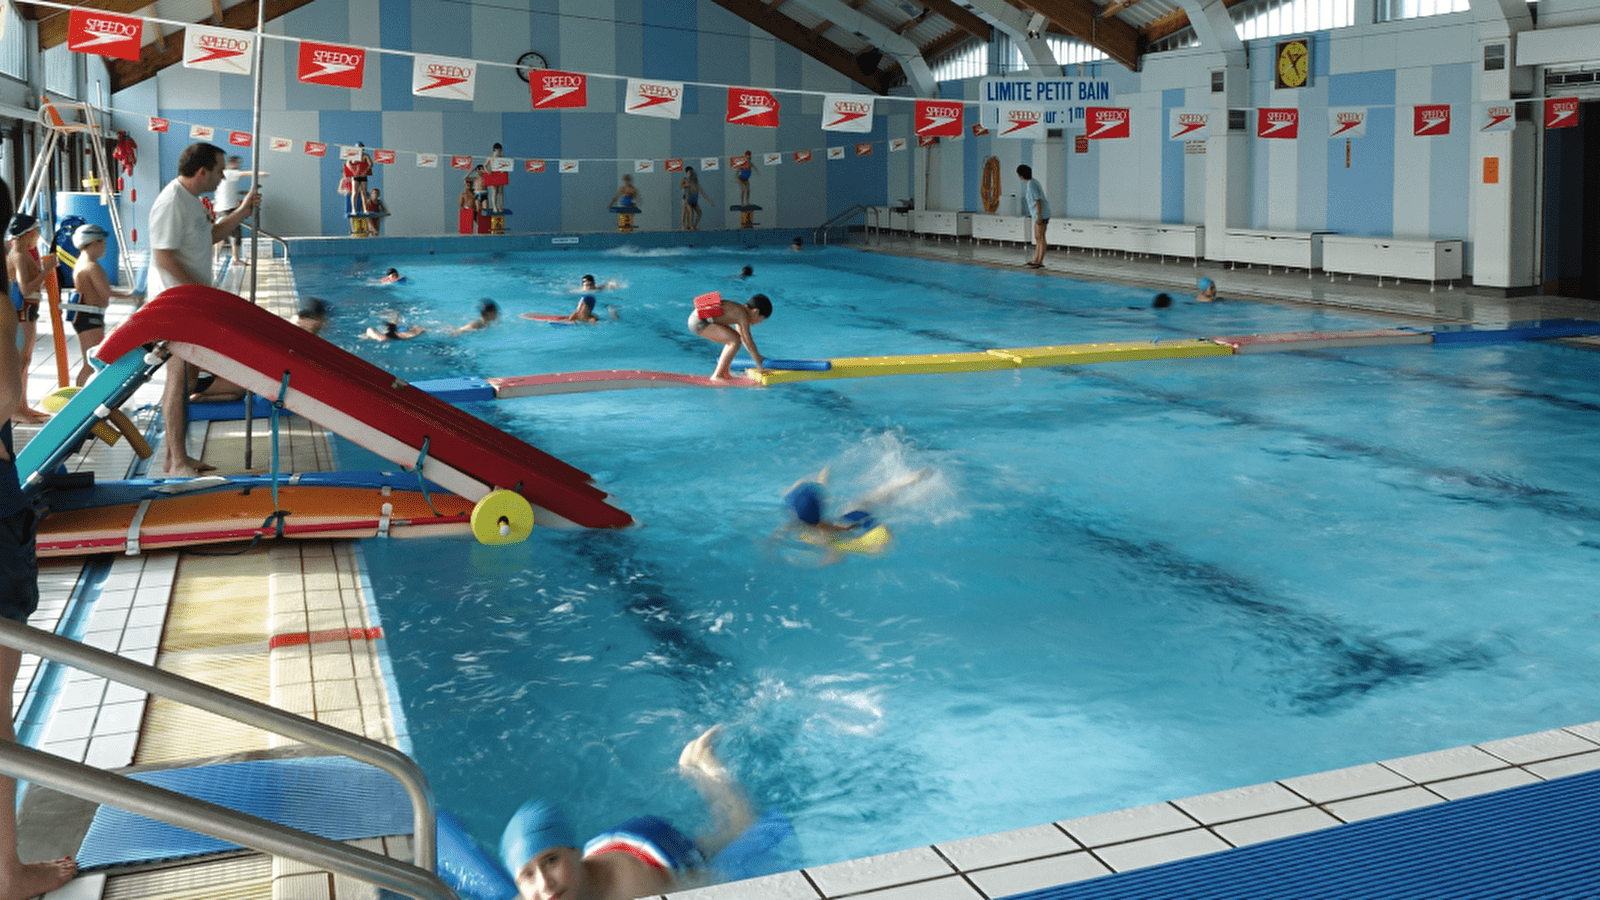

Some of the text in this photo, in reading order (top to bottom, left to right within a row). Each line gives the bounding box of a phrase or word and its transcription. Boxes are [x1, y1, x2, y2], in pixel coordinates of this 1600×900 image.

[85, 17, 137, 37] SPEEDO
[199, 34, 248, 51] SPEEDO
[313, 49, 360, 66] SPEEDO
[427, 64, 470, 79] SPEEDO
[542, 75, 582, 88] SPEEDO
[639, 83, 679, 98] SPEEDO
[987, 81, 1109, 101] LIMITE PETIT BAIN
[834, 101, 870, 113] SPEEDO
[926, 106, 959, 118] SPEEDO
[1008, 110, 1041, 120] SPEEDO
[1095, 111, 1127, 121] SPEEDO
[1179, 113, 1209, 123] SPEEDO
[1266, 111, 1296, 122] SPEEDO
